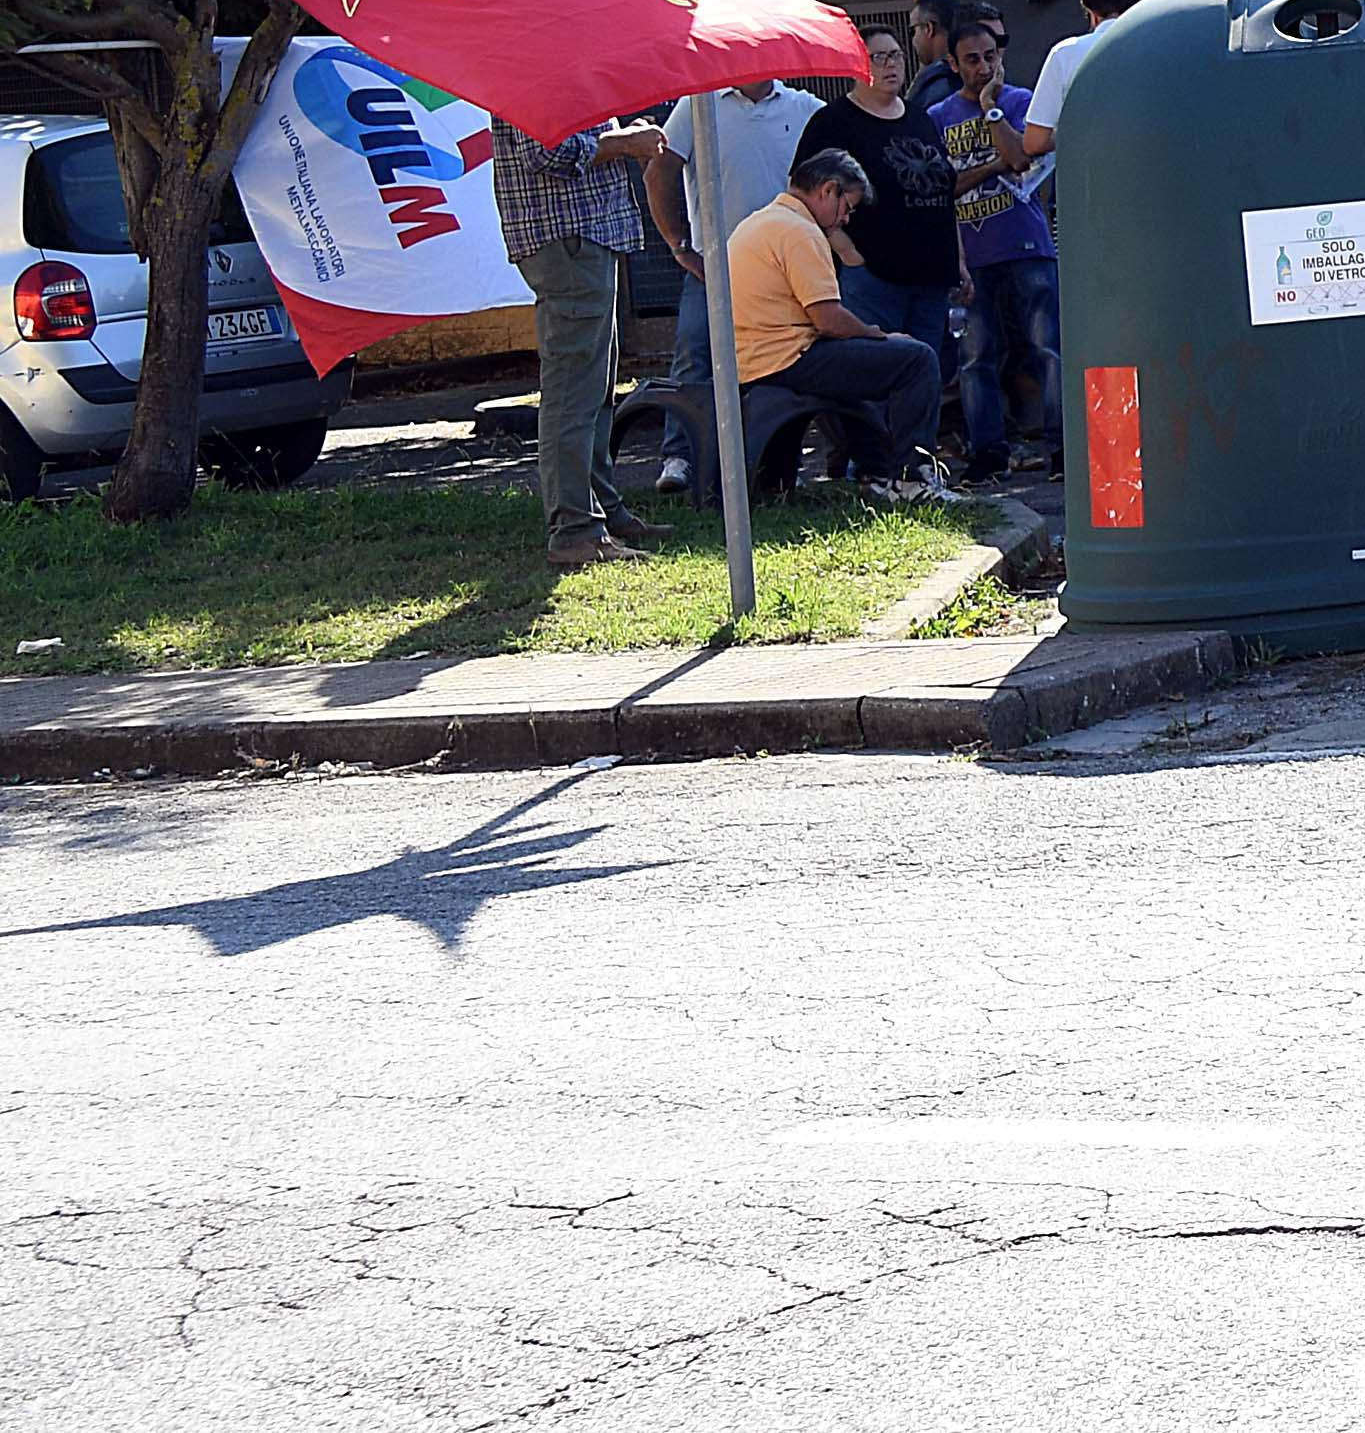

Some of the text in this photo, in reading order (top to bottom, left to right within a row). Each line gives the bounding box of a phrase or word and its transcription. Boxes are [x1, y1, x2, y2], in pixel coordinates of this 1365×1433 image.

[345, 86, 462, 250] UILM
[278, 114, 346, 278] UNIONE ITALIANA LAVORATORI
[286, 185, 331, 283] METALMECCANICI
[1321, 239, 1356, 254] SOLO
[1313, 271, 1326, 283] DI
[1276, 290, 1297, 303] NO
[214, 311, 268, 338] 234GF
